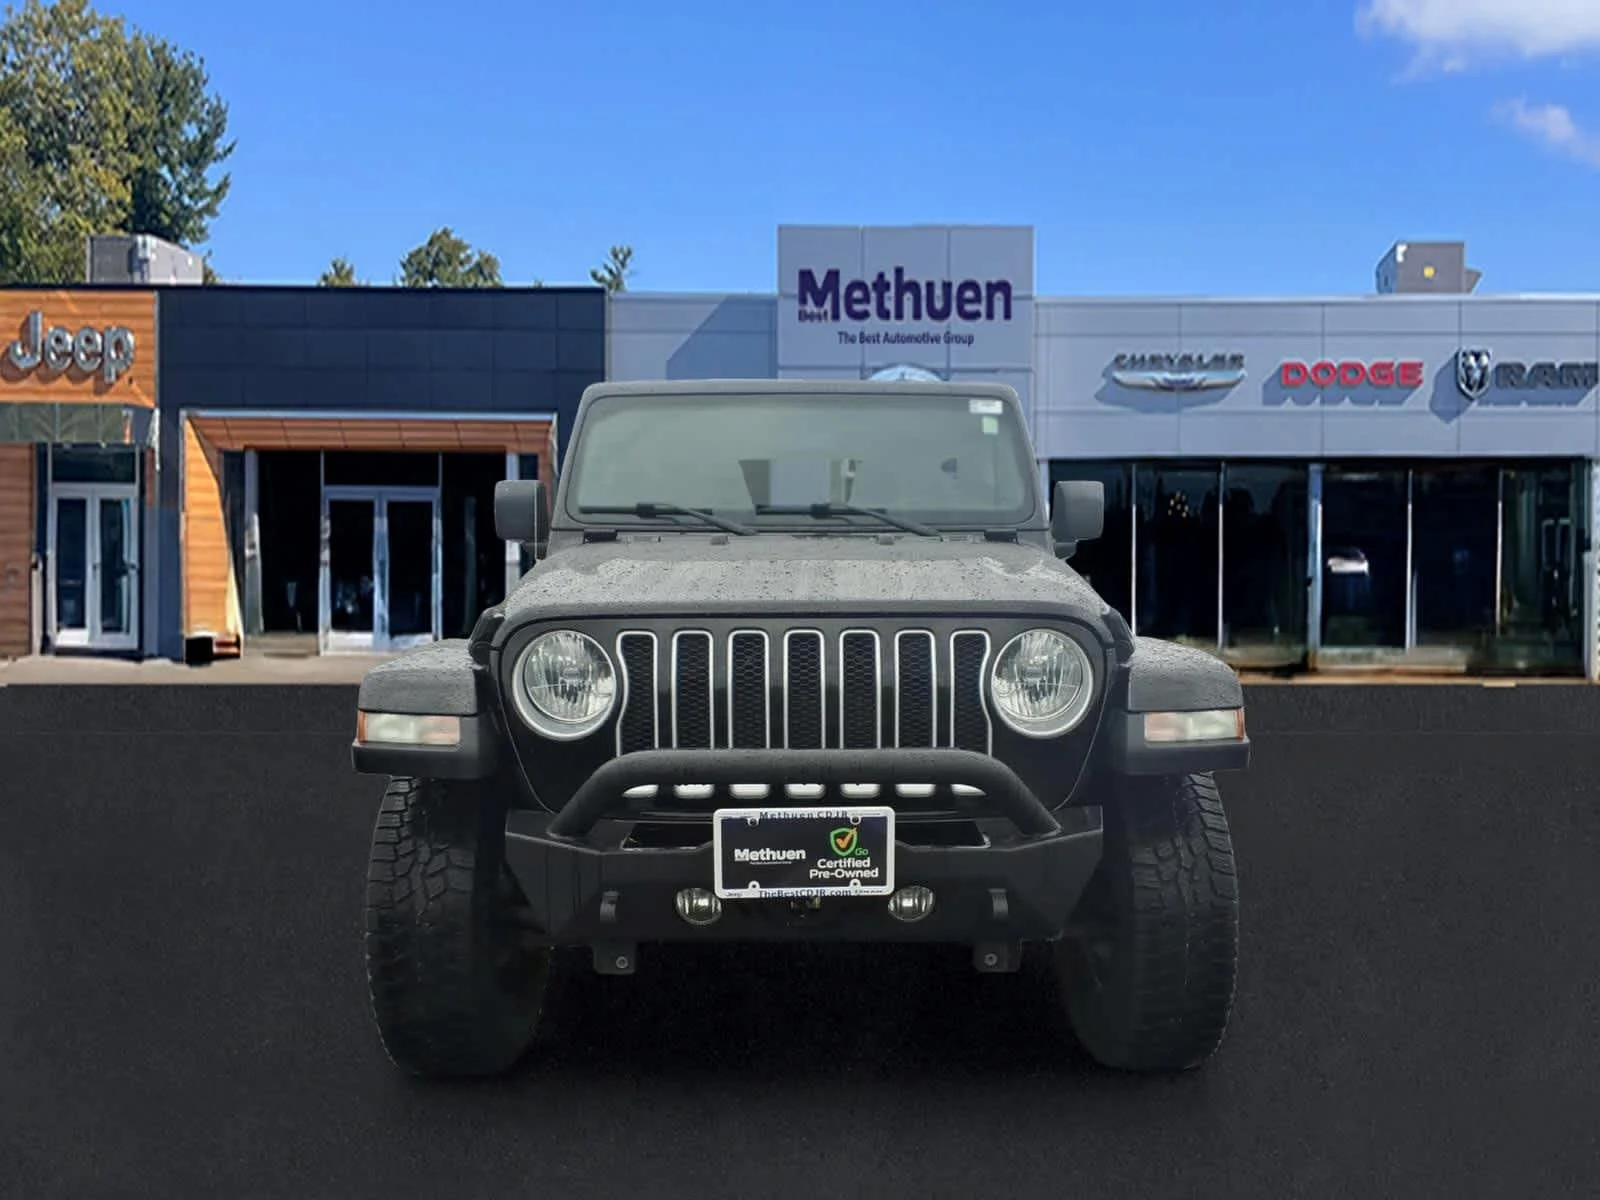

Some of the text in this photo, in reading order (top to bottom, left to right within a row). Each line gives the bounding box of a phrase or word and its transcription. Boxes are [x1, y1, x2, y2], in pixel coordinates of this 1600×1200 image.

[798, 266, 1012, 321] Methuen
[9, 310, 135, 383] Jeep
[838, 330, 974, 347] The Best Automotive Group
[1281, 361, 1423, 386] DODGE
[1496, 362, 1599, 387] RAM
[734, 848, 806, 861] Methuen
[855, 847, 869, 856] Go
[817, 857, 871, 868] Certified
[809, 867, 879, 879] Pre-Owned
